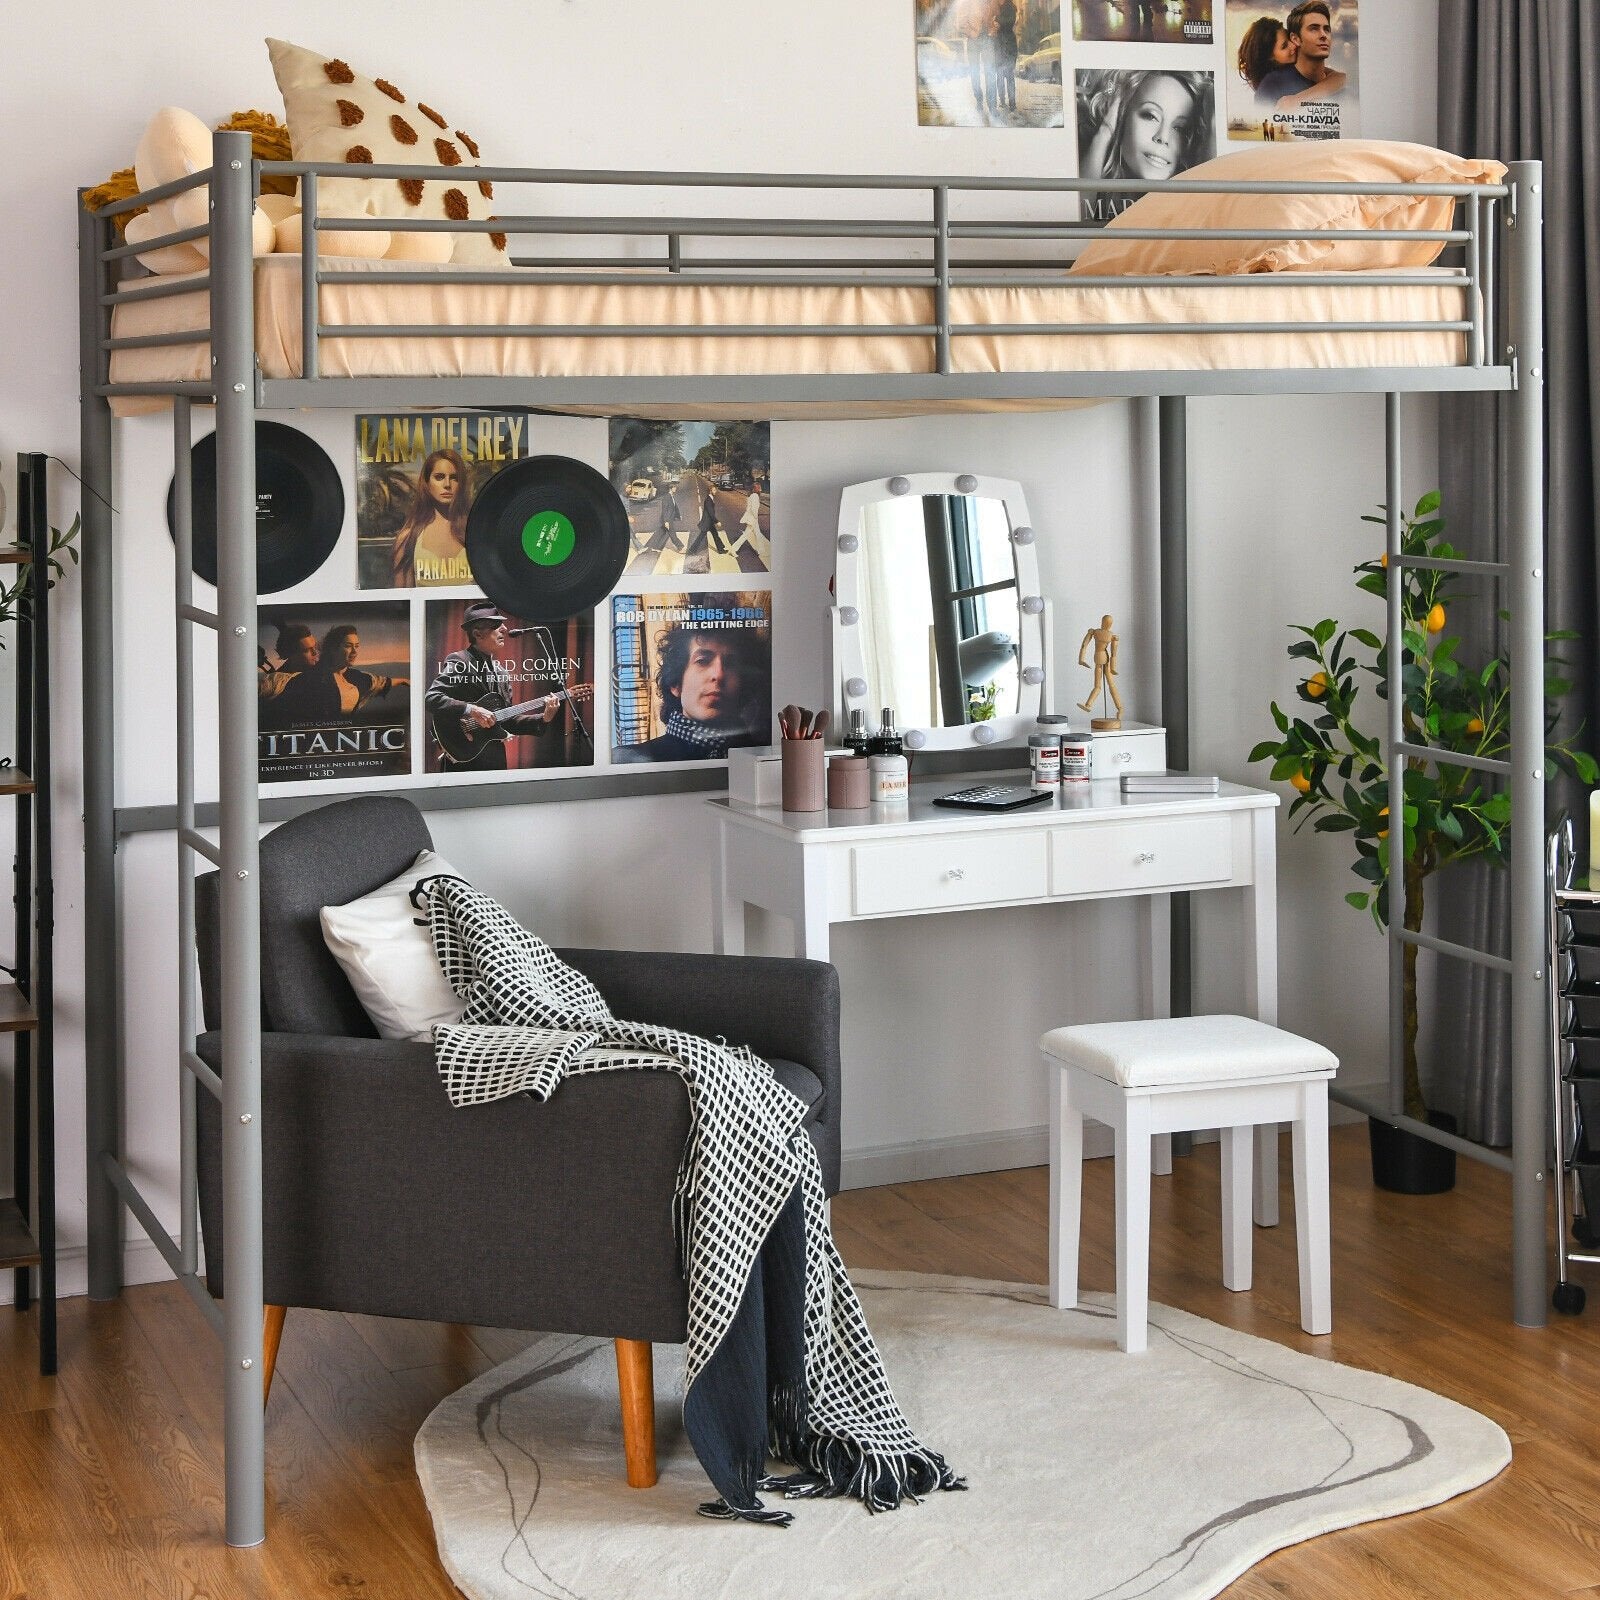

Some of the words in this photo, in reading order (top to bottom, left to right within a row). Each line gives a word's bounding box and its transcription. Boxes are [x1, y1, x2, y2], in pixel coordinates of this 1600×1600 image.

[1307, 107, 1340, 116] ЧАРЛИ
[1273, 114, 1340, 125] САН-КЛАУДА
[361, 417, 426, 463] LANA
[431, 417, 474, 461] DEL
[478, 416, 524, 461] REY
[616, 610, 645, 623] BOB
[648, 609, 690, 622] DYLAN
[690, 607, 764, 621] 1965-1966
[681, 621, 699, 630] THE
[700, 620, 743, 629] CUTTING
[745, 619, 769, 628] EDGE
[438, 659, 516, 675] LEONARD
[522, 657, 581, 672] COHEN
[449, 675, 469, 684] LIVE
[472, 674, 483, 683] IN
[486, 672, 549, 683] FREDERICTON
[258, 728, 405, 757] ITANIC
[261, 764, 303, 772] EXPERIENCE
[320, 769, 335, 777] 3D
